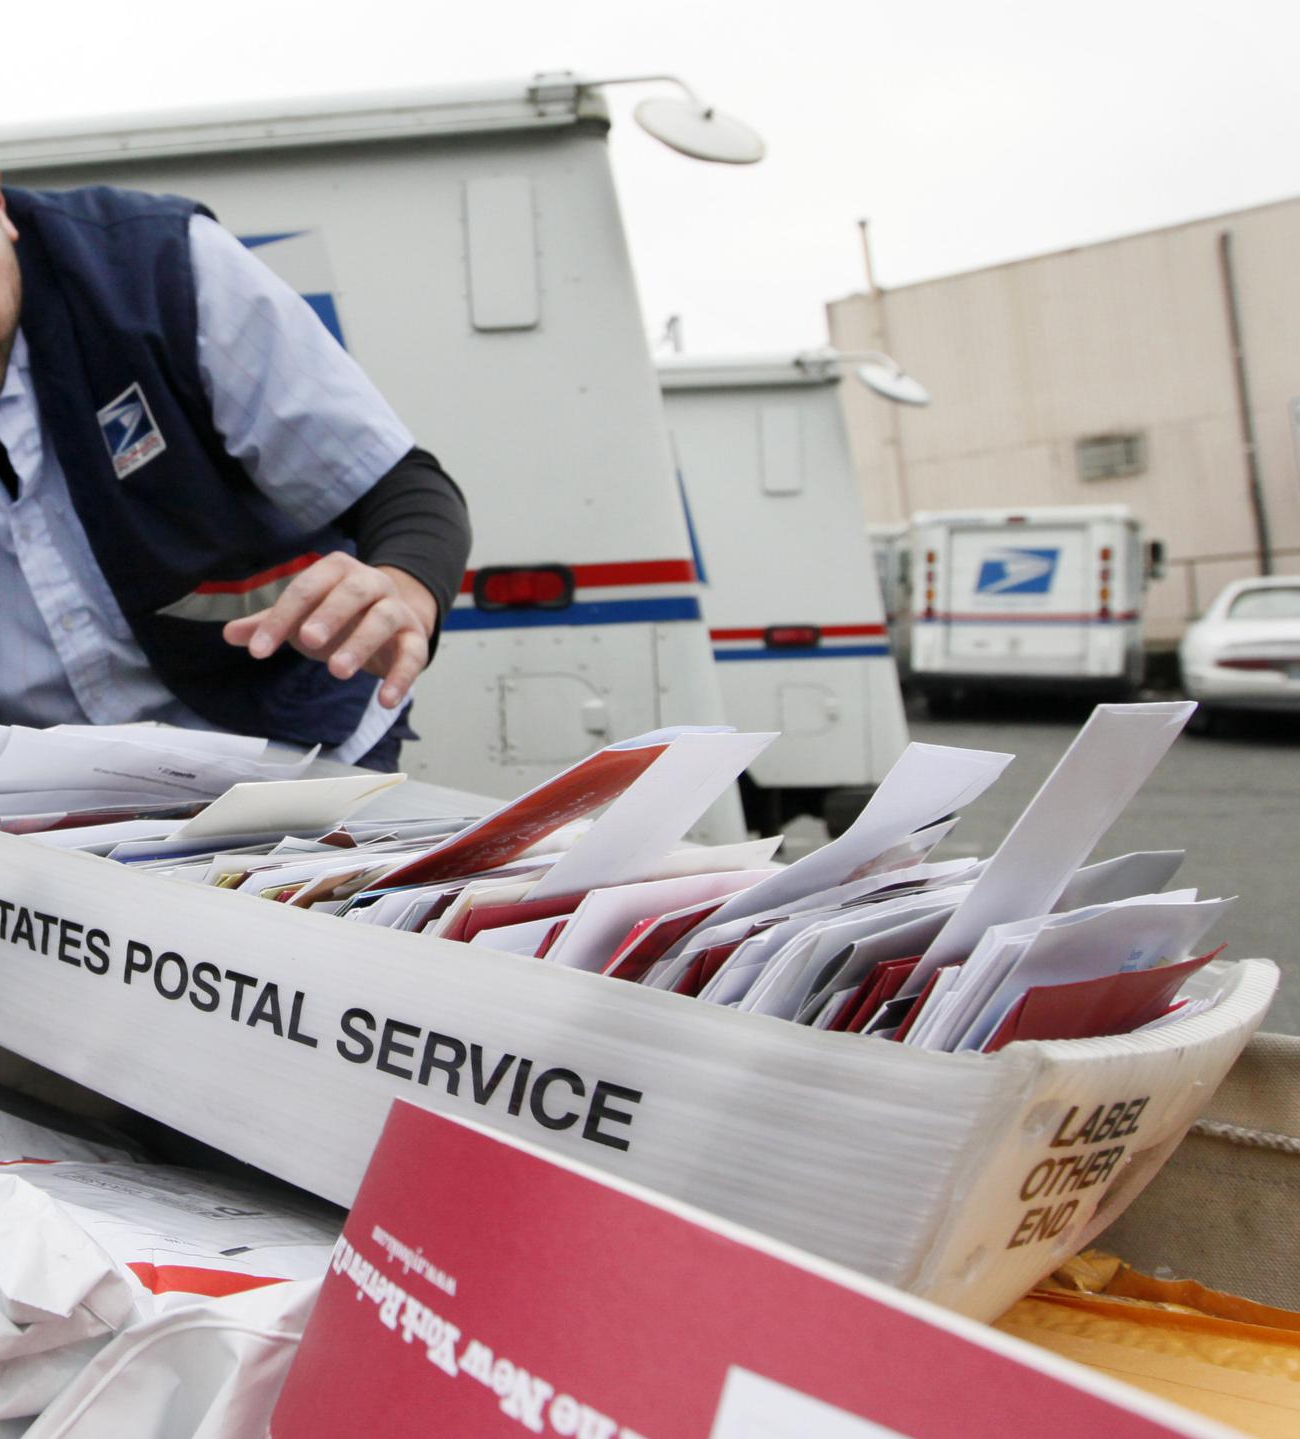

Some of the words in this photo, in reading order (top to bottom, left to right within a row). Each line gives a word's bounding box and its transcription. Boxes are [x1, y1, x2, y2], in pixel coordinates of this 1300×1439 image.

[123, 939, 319, 1049] POSTAL
[336, 1007, 643, 1152] SERVICE
[1050, 1096, 1150, 1148] LABEL
[1020, 1145, 1126, 1202] OTHER
[1006, 1199, 1080, 1250] END
[400, 1296, 463, 1378] York
[457, 1338, 556, 1434] New
